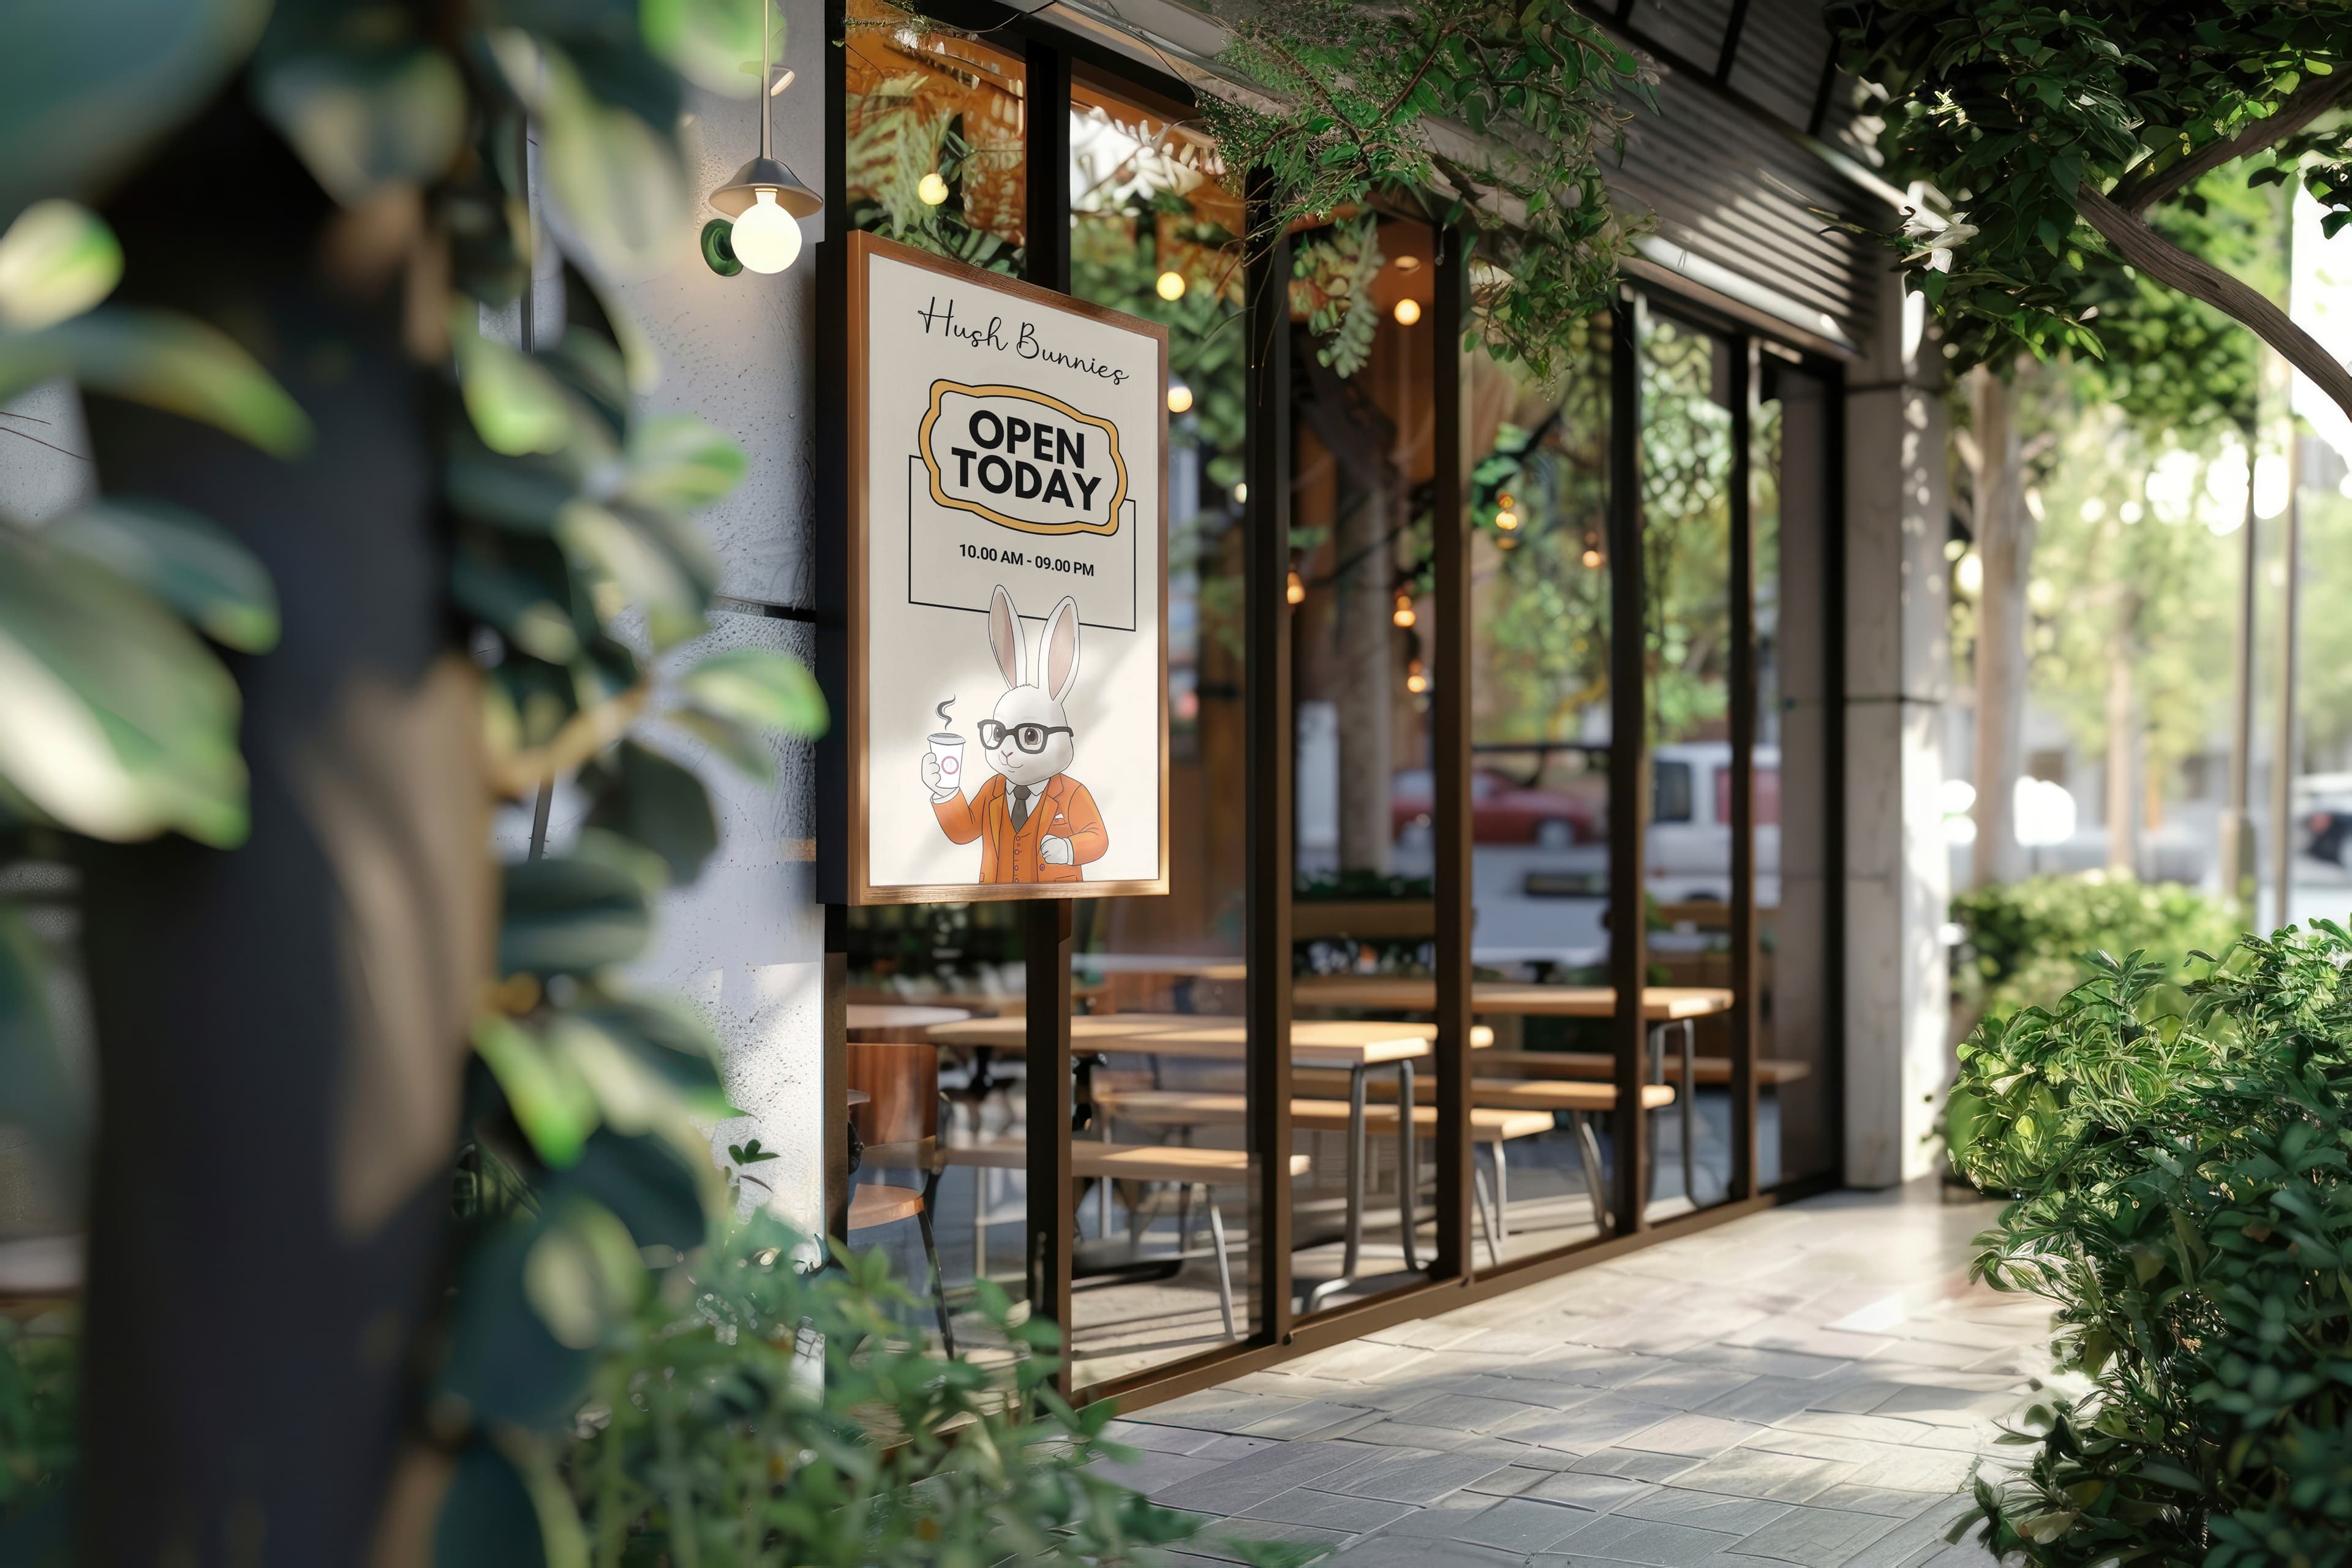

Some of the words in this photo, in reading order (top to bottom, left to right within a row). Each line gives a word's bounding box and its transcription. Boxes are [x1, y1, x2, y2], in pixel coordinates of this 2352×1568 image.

[918, 296, 1008, 351] Hush
[1017, 322, 1129, 385] Bunnies
[969, 410, 1085, 469] OPEN
[951, 447, 1102, 511] TODAY
[959, 544, 997, 562] 10.00
[1000, 550, 1023, 566] AM
[1035, 556, 1071, 573] 09.00
[1074, 562, 1095, 577] PM
